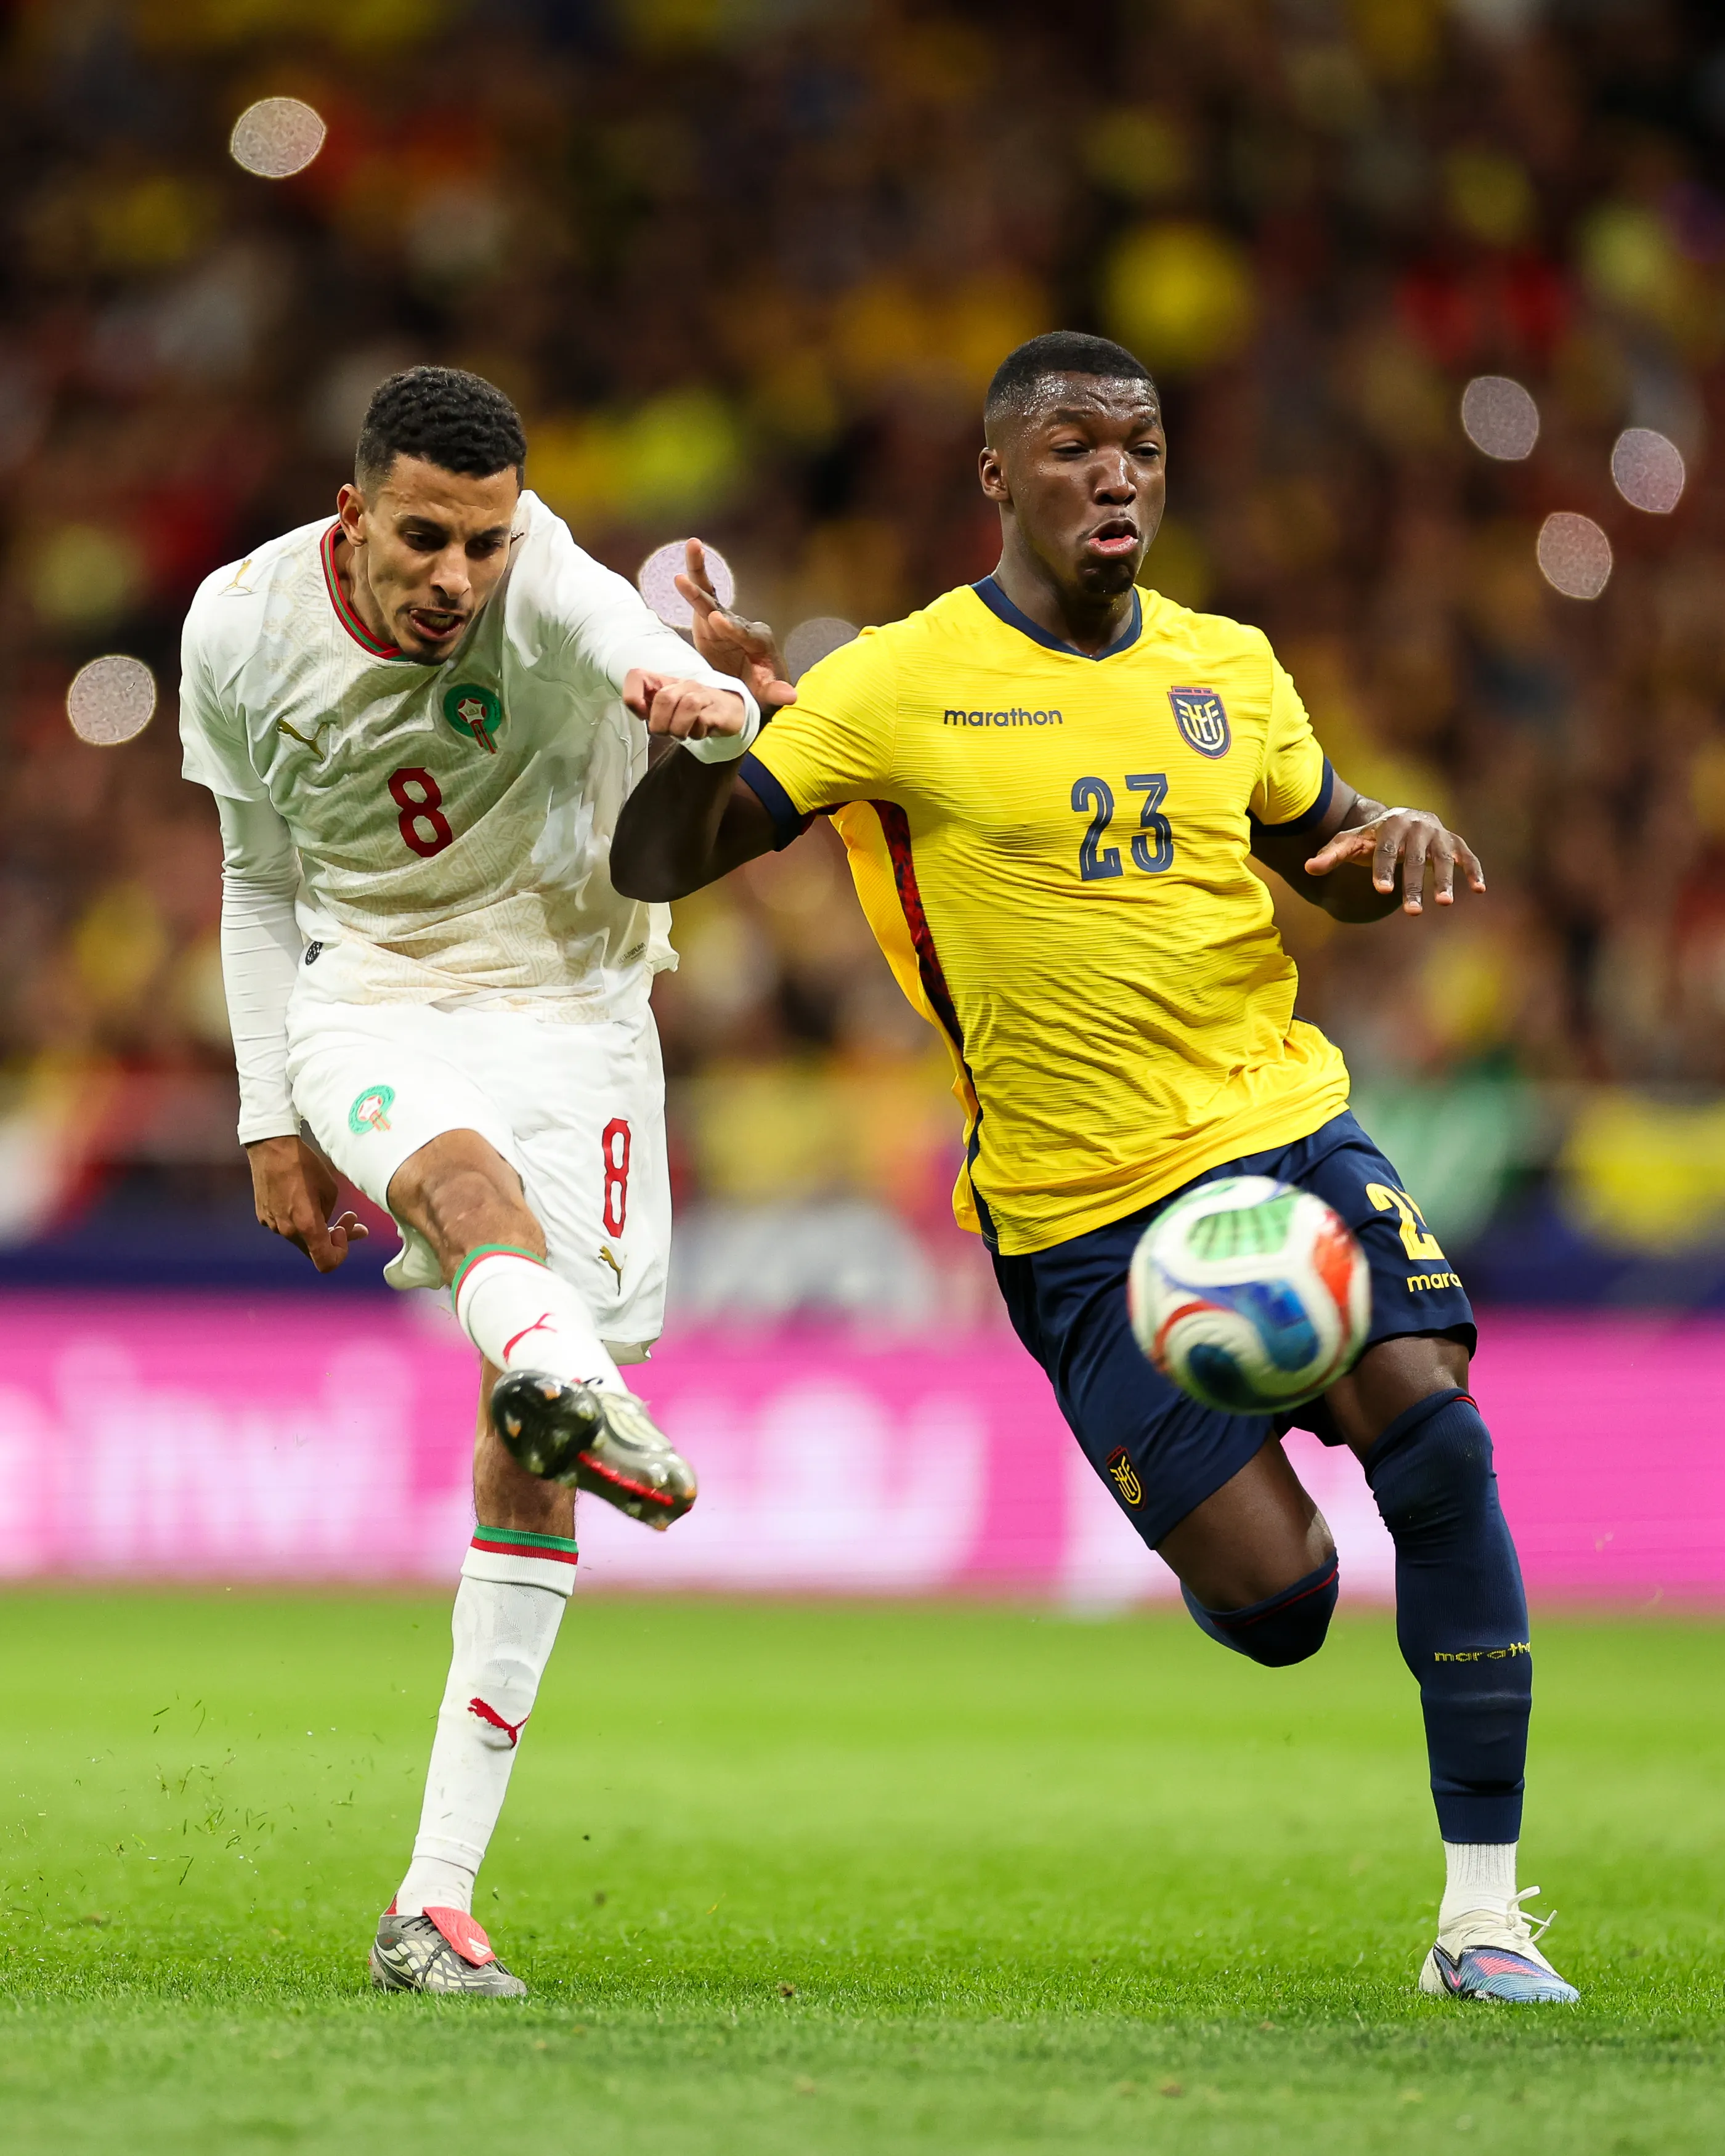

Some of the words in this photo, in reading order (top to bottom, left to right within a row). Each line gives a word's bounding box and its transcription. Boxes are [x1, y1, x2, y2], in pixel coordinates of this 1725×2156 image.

[944, 708, 1063, 726] marathon
[388, 767, 453, 857] 8
[1071, 773, 1174, 881] 23
[602, 1117, 631, 1239] 8
